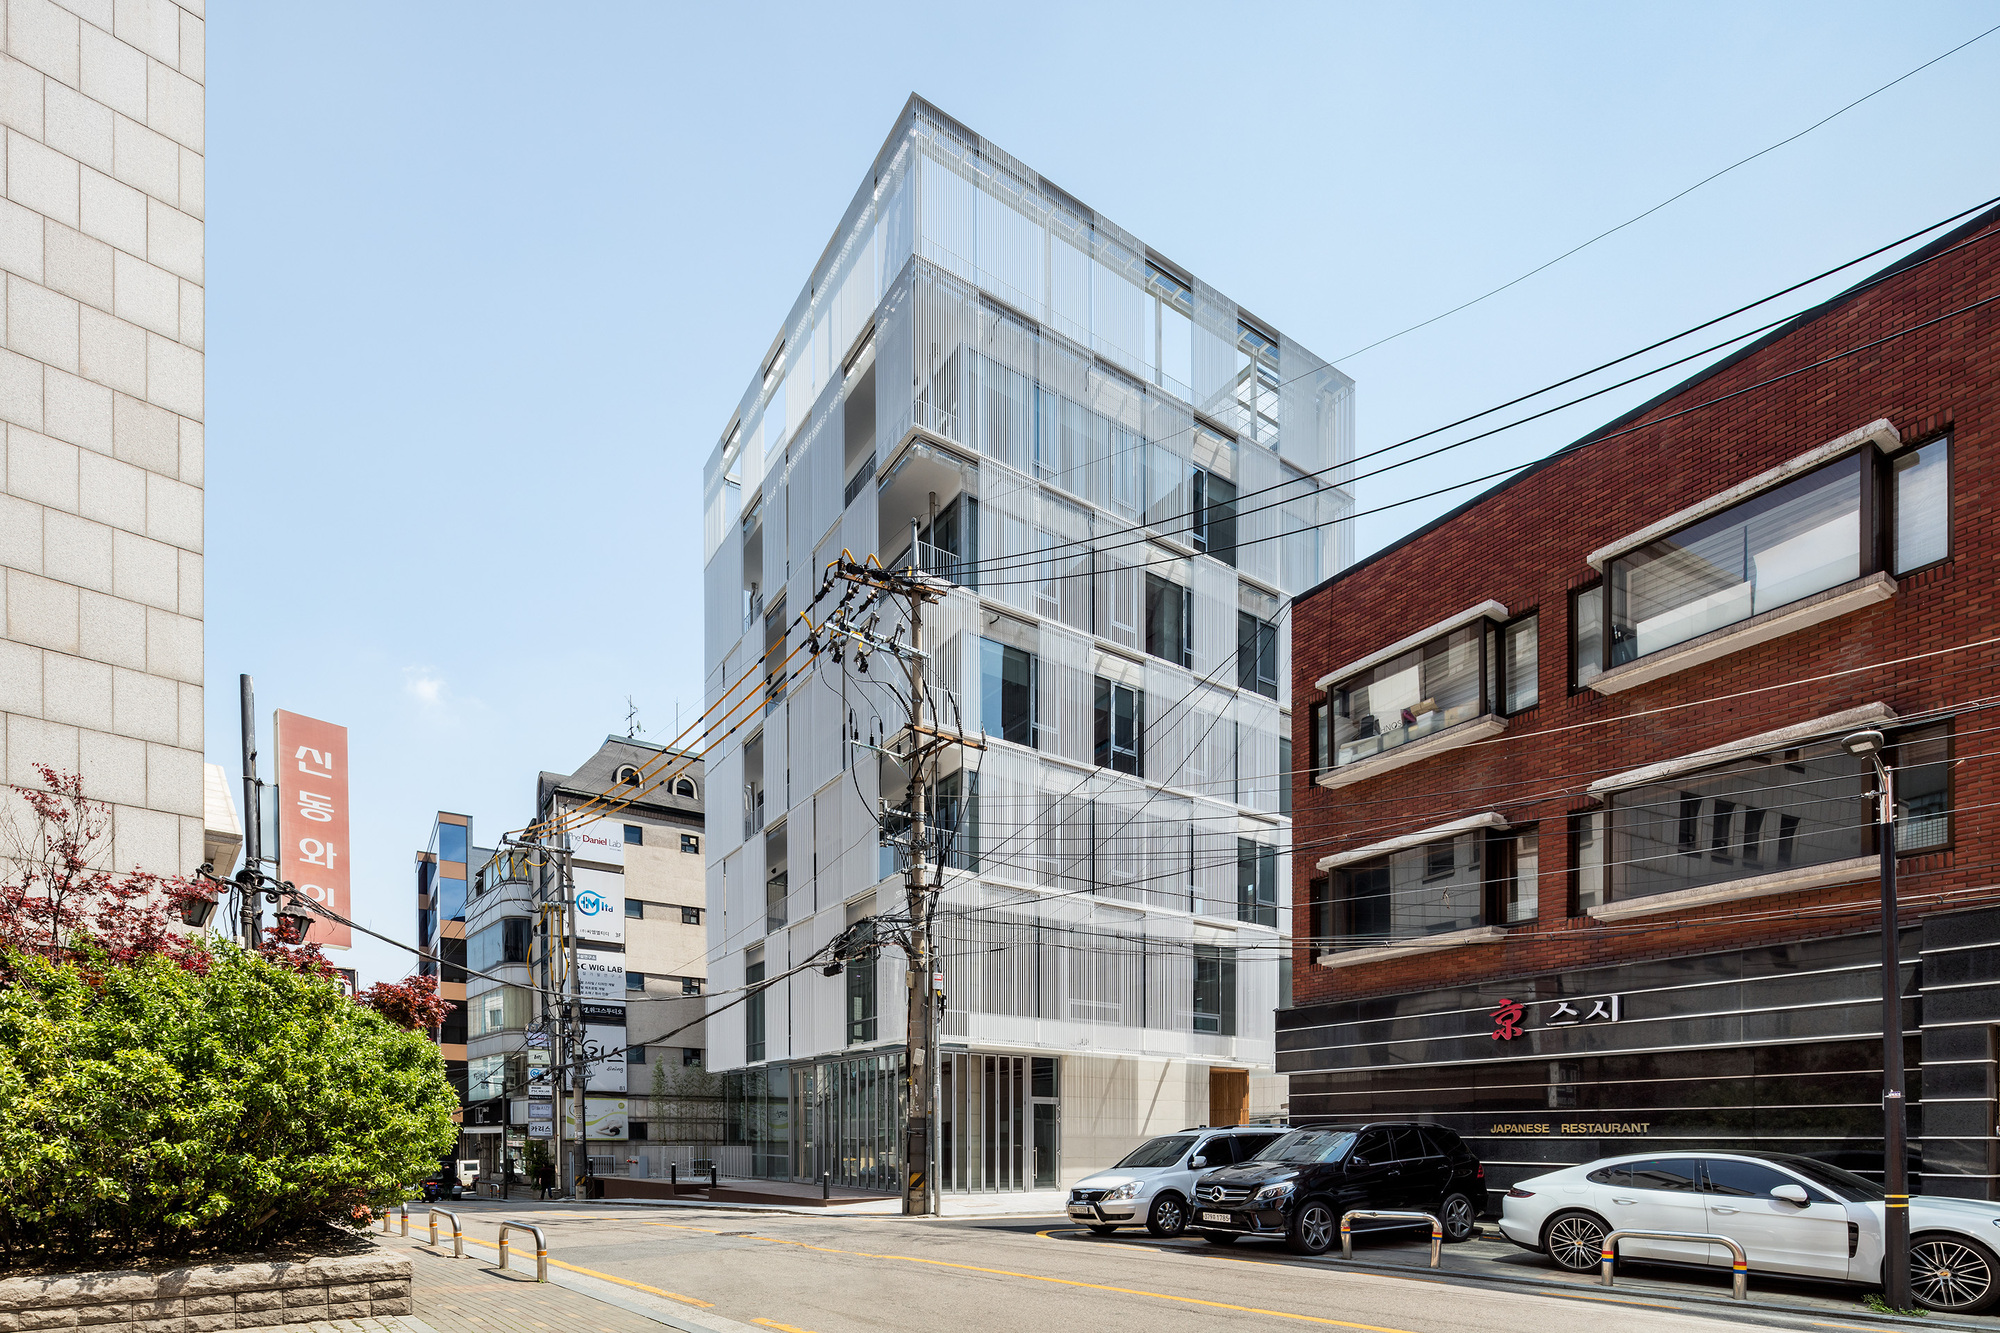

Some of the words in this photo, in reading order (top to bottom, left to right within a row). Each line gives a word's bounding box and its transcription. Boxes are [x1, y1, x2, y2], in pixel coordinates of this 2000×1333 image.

[582, 834, 607, 846] Daniel
[608, 838, 622, 848] Lab
[589, 963, 605, 972] WIG
[607, 965, 623, 974] LAB
[1545, 994, 1619, 1027] 스시
[530, 1125, 551, 1133] 카리스
[1490, 1123, 1551, 1134] JAPANESE
[1560, 1122, 1651, 1134] RESTAURANT
